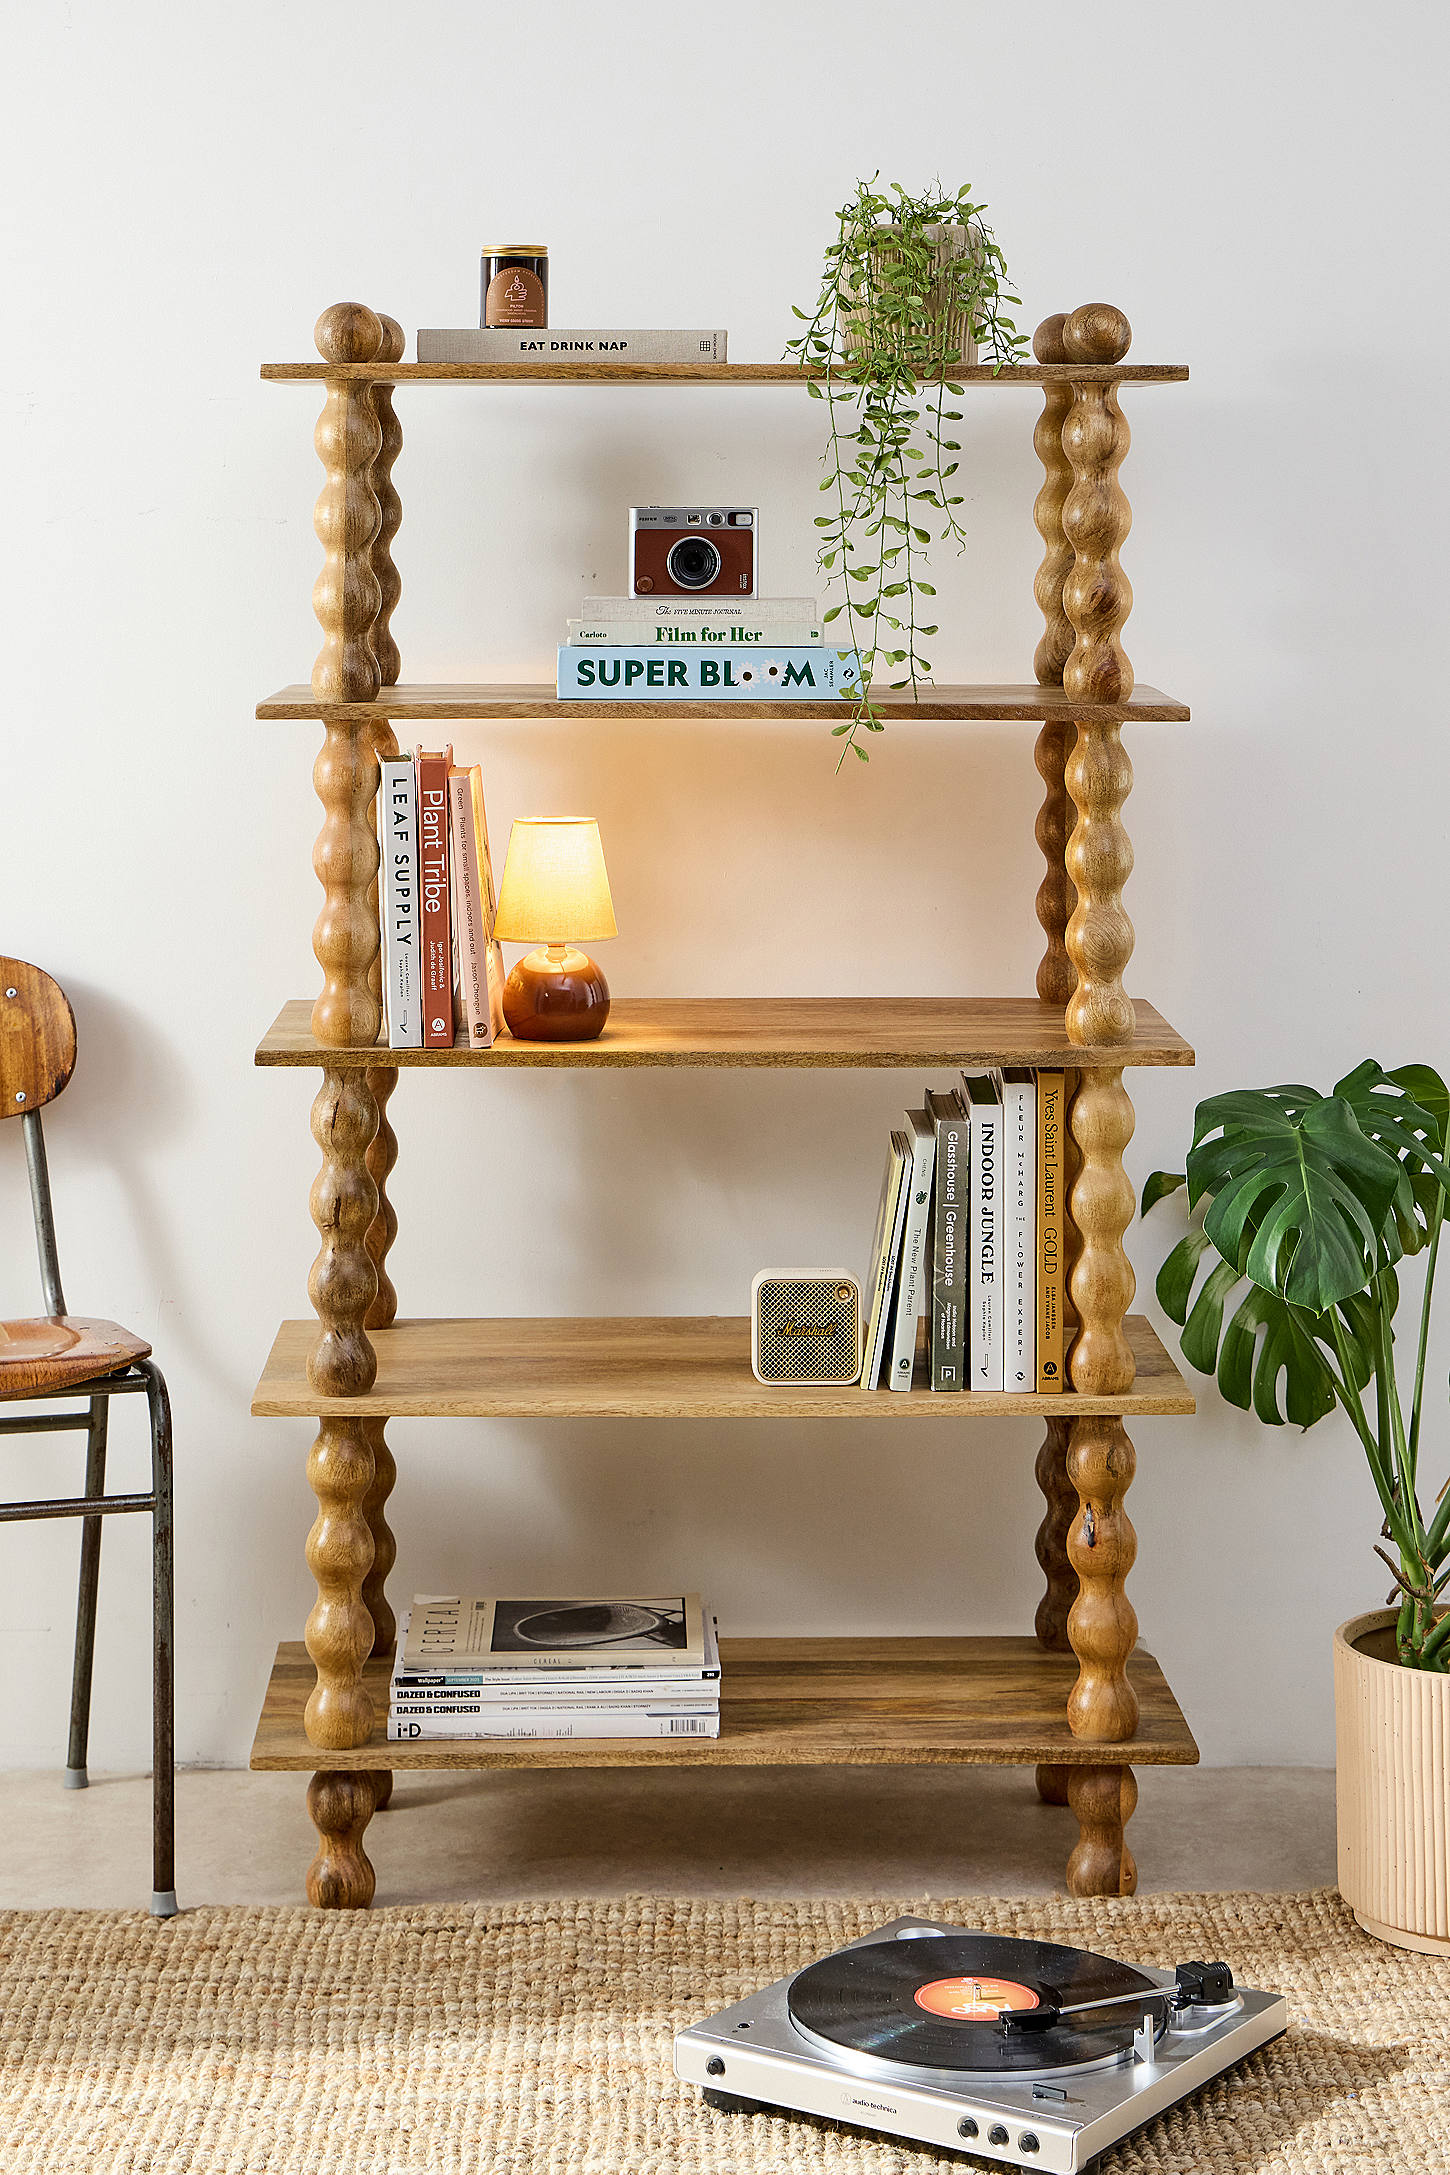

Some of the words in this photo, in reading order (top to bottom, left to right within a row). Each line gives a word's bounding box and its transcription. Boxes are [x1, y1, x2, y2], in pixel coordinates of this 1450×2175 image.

[520, 341, 546, 351] EAT
[550, 341, 594, 351] DRINK
[598, 341, 628, 351] NAP
[655, 605, 671, 616] The
[579, 630, 608, 639] Carloto
[655, 626, 698, 642] Film
[701, 626, 727, 642] for
[730, 626, 763, 642] Her
[576, 659, 689, 687] SUPER
[456, 787, 464, 810] Green
[392, 778, 409, 842] LEAF
[423, 790, 445, 849] Plant
[459, 817, 467, 839] Plants
[462, 852, 471, 873] small
[424, 853, 447, 913] Tribe
[394, 854, 412, 946] SUPPLY
[429, 940, 437, 961] Judith
[469, 943, 477, 955] out
[430, 961, 436, 969] de
[1045, 1089, 1058, 1121] Yves
[1045, 1123, 1058, 1158] Saint
[920, 1158, 928, 1178] CHENG
[946, 1130, 959, 1201] Glasshouse
[980, 1122, 995, 1201] INDOOR
[1045, 1162, 1058, 1217] Laurent
[913, 1228, 922, 1244] The
[980, 1206, 995, 1285] JUNGLE
[911, 1246, 920, 1265] New
[944, 1211, 957, 1287] Greenhouse
[1017, 1231, 1025, 1289] FLOWER
[1043, 1227, 1058, 1275] GOLD
[908, 1266, 918, 1288] Plant
[905, 1289, 916, 1317] Parent
[776, 1320, 838, 1337] Marshall
[396, 1691, 426, 1699] DAZED
[433, 1690, 481, 1698] CONFUSED
[396, 1706, 425, 1714] DAZED
[426, 1706, 432, 1714] &
[433, 1705, 481, 1714] CONFUSED
[397, 1722, 422, 1738] i-D
